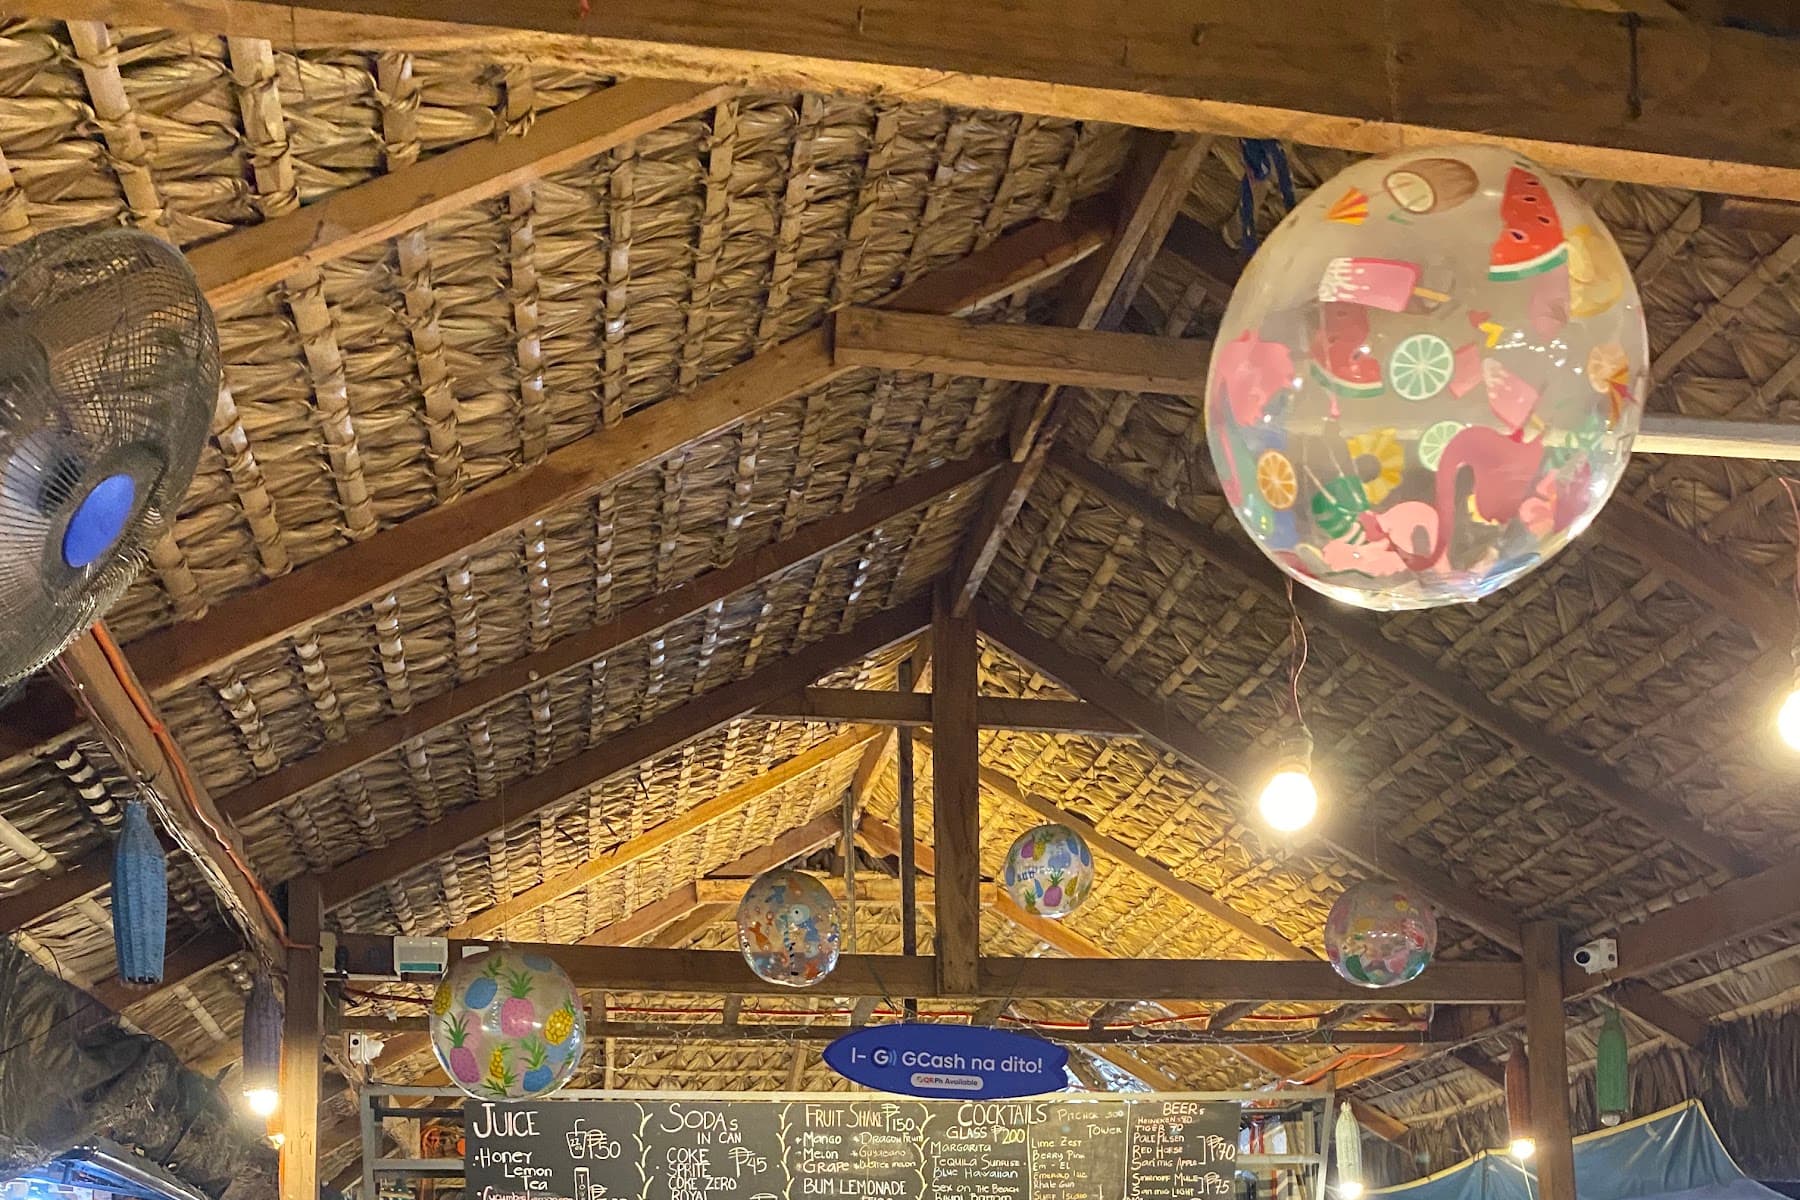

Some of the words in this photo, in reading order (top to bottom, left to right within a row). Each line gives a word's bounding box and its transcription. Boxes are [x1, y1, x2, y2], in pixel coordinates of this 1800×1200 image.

[901, 1050, 965, 1070] GCash
[971, 1057, 995, 1071] na
[1000, 1056, 1043, 1074] dito!
[473, 1103, 541, 1138] JUICE
[805, 1103, 844, 1128] FRUIT
[846, 1102, 883, 1128] SHAKE
[957, 1103, 1048, 1127] COCKTAILS
[697, 1132, 711, 1144] IN
[719, 1132, 741, 1144] CAN
[945, 1126, 988, 1140] GLASS
[479, 1147, 533, 1169] Honey
[666, 1147, 709, 1164] COKE
[504, 1164, 553, 1178] Lemon
[667, 1160, 711, 1178] SPRITE
[520, 1175, 548, 1191] Tea
[668, 1175, 698, 1190] COKE
[705, 1177, 737, 1191] ZERO
[803, 1178, 834, 1195] BUM
[839, 1179, 907, 1196] LEMONADE
